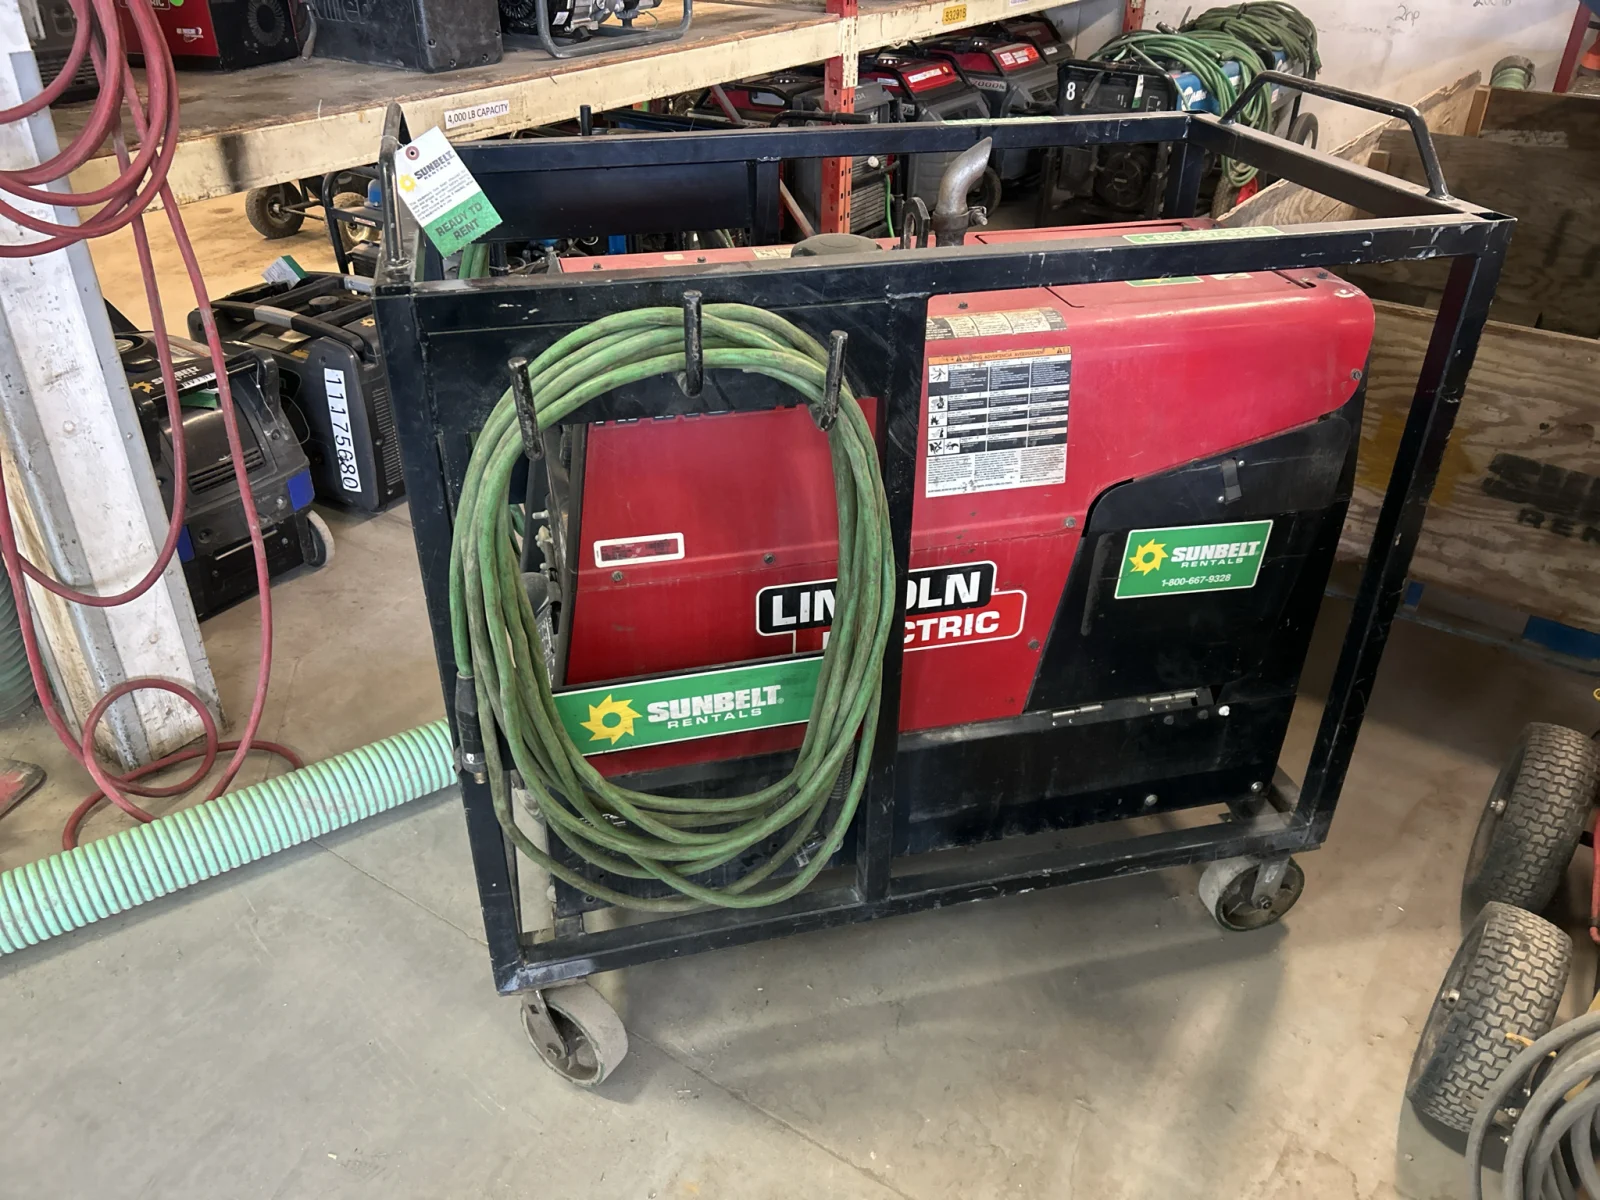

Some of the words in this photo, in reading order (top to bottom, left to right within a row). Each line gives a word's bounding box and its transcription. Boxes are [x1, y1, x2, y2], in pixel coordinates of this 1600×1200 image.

[1066, 82, 1076, 101] 8
[448, 111, 467, 125] 4,000
[467, 109, 476, 120] LB
[476, 103, 509, 118] CAPACITY
[414, 150, 455, 180] SUNBELT
[434, 210, 469, 238] READY
[468, 201, 484, 216] TO
[453, 218, 481, 241] RENT
[325, 376, 360, 490] 11175680
[1171, 541, 1261, 563] SUNBELT
[1181, 557, 1244, 568] RENTALS
[1162, 573, 1232, 587] 1-800-667-9328
[772, 571, 981, 627] LINLN
[647, 685, 782, 723] SUNBELT
[667, 708, 762, 729] RENTALS
